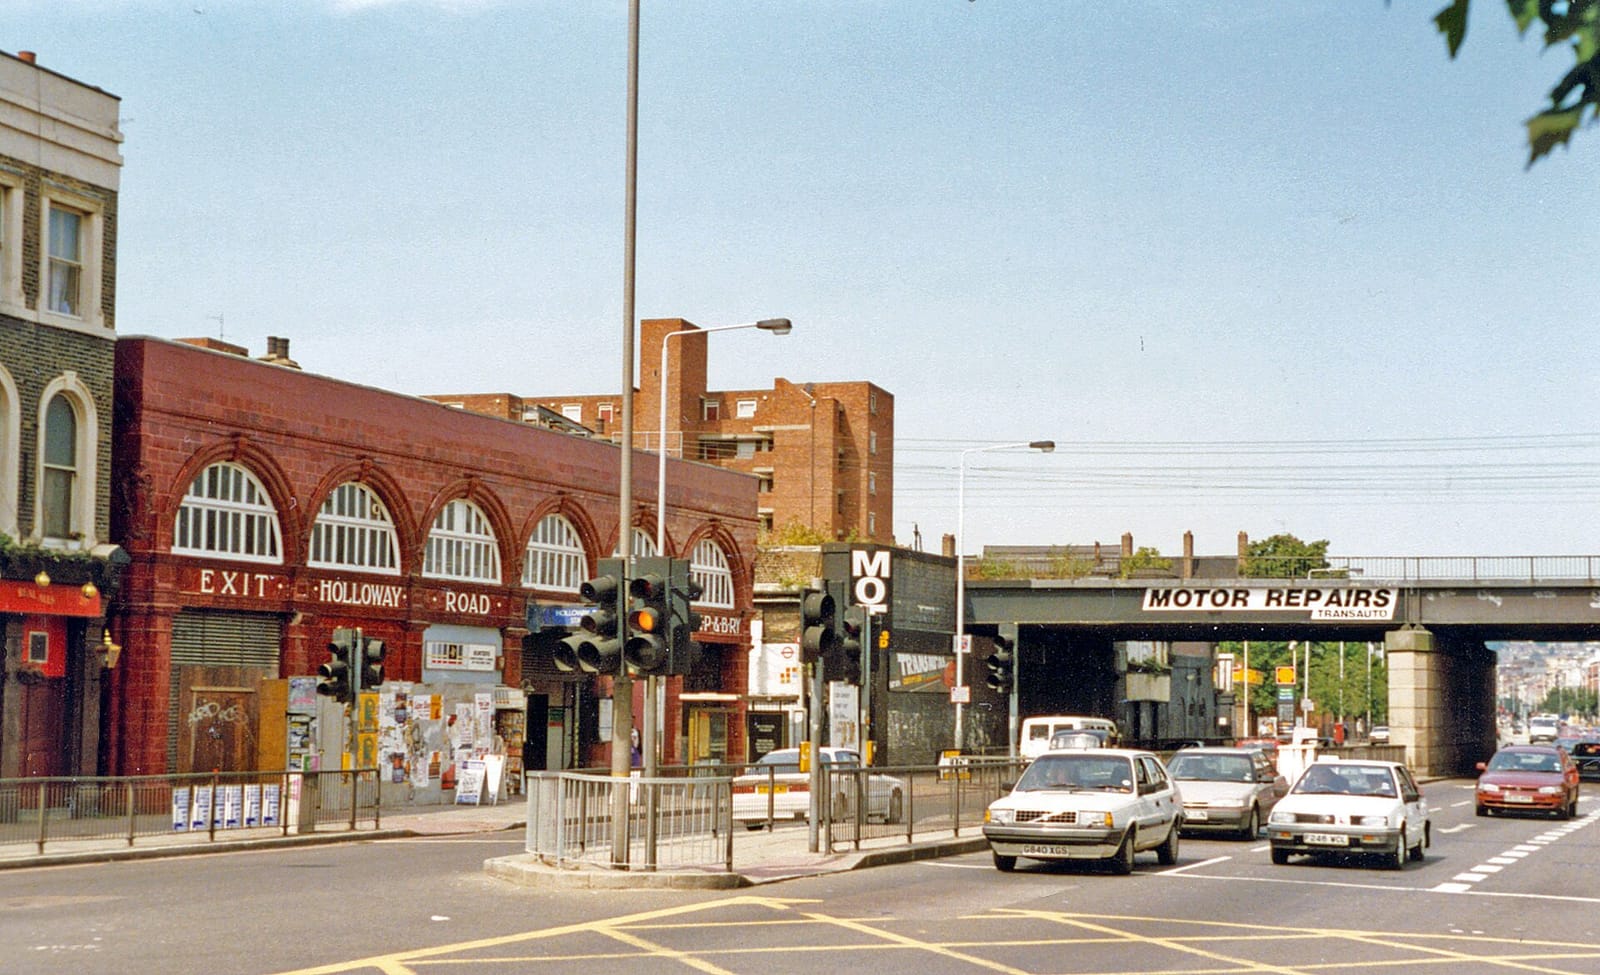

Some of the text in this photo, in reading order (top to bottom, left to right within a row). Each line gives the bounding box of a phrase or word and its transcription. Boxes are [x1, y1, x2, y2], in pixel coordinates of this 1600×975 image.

[201, 569, 269, 597] EXIT
[320, 580, 490, 614] HOLLOWAY ROAD
[1149, 588, 1391, 607] MOTOR REPAIRS
[1318, 609, 1388, 618] TRANSAUTO
